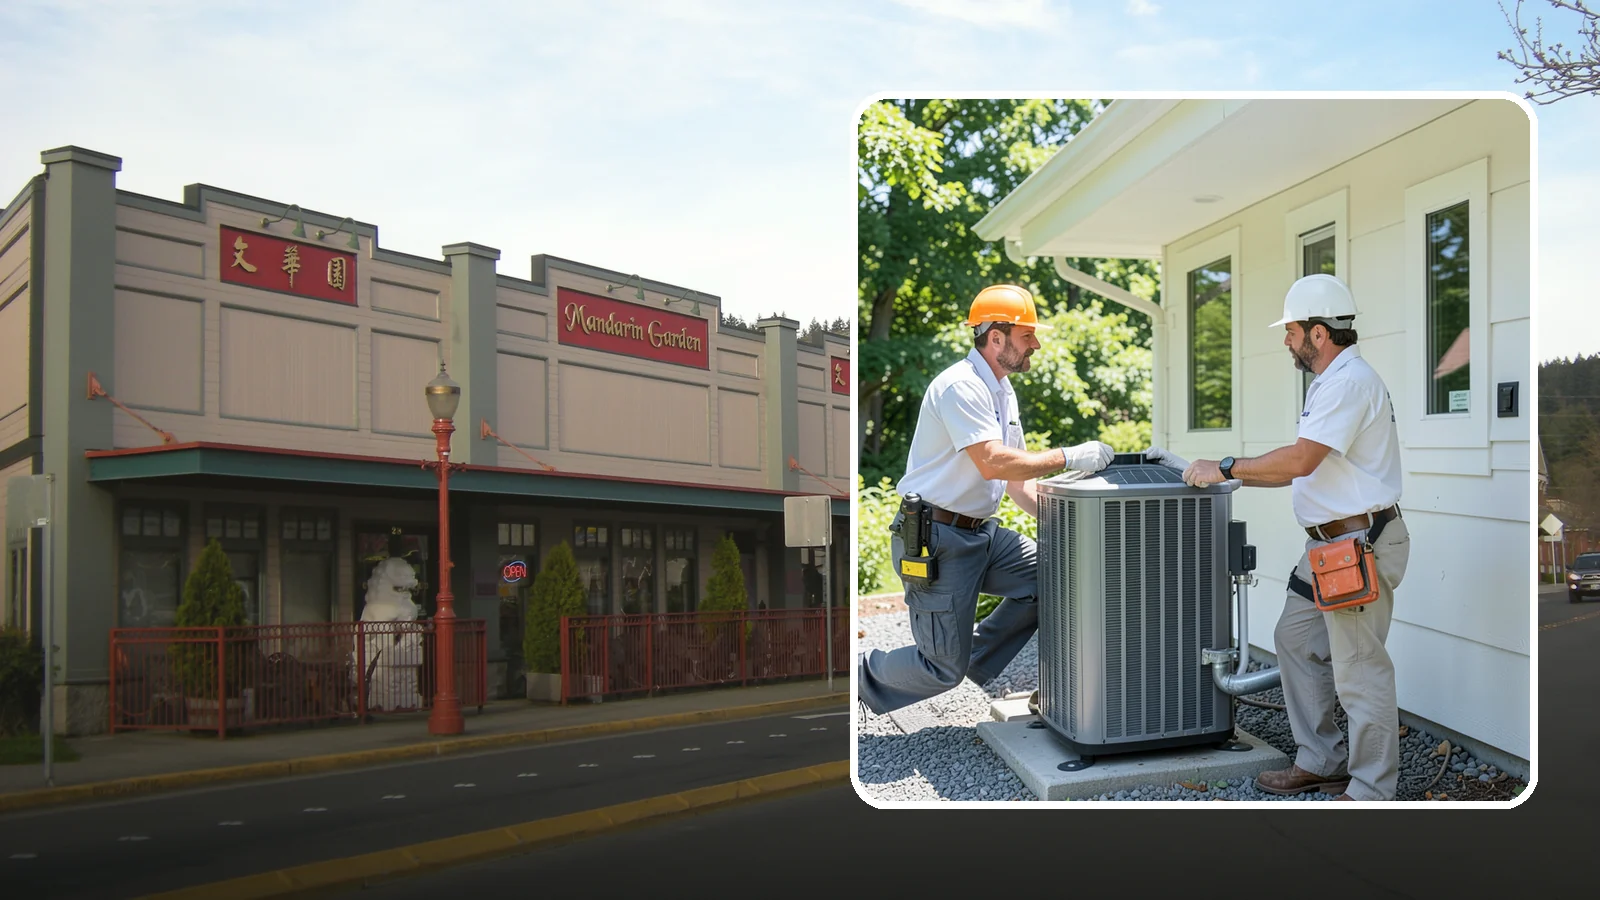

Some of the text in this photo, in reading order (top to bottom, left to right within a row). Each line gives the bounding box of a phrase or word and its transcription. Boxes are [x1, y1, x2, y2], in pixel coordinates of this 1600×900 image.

[231, 235, 346, 291] 文華園
[564, 302, 701, 352] Mandarin Garden
[503, 565, 527, 578] OPEN
